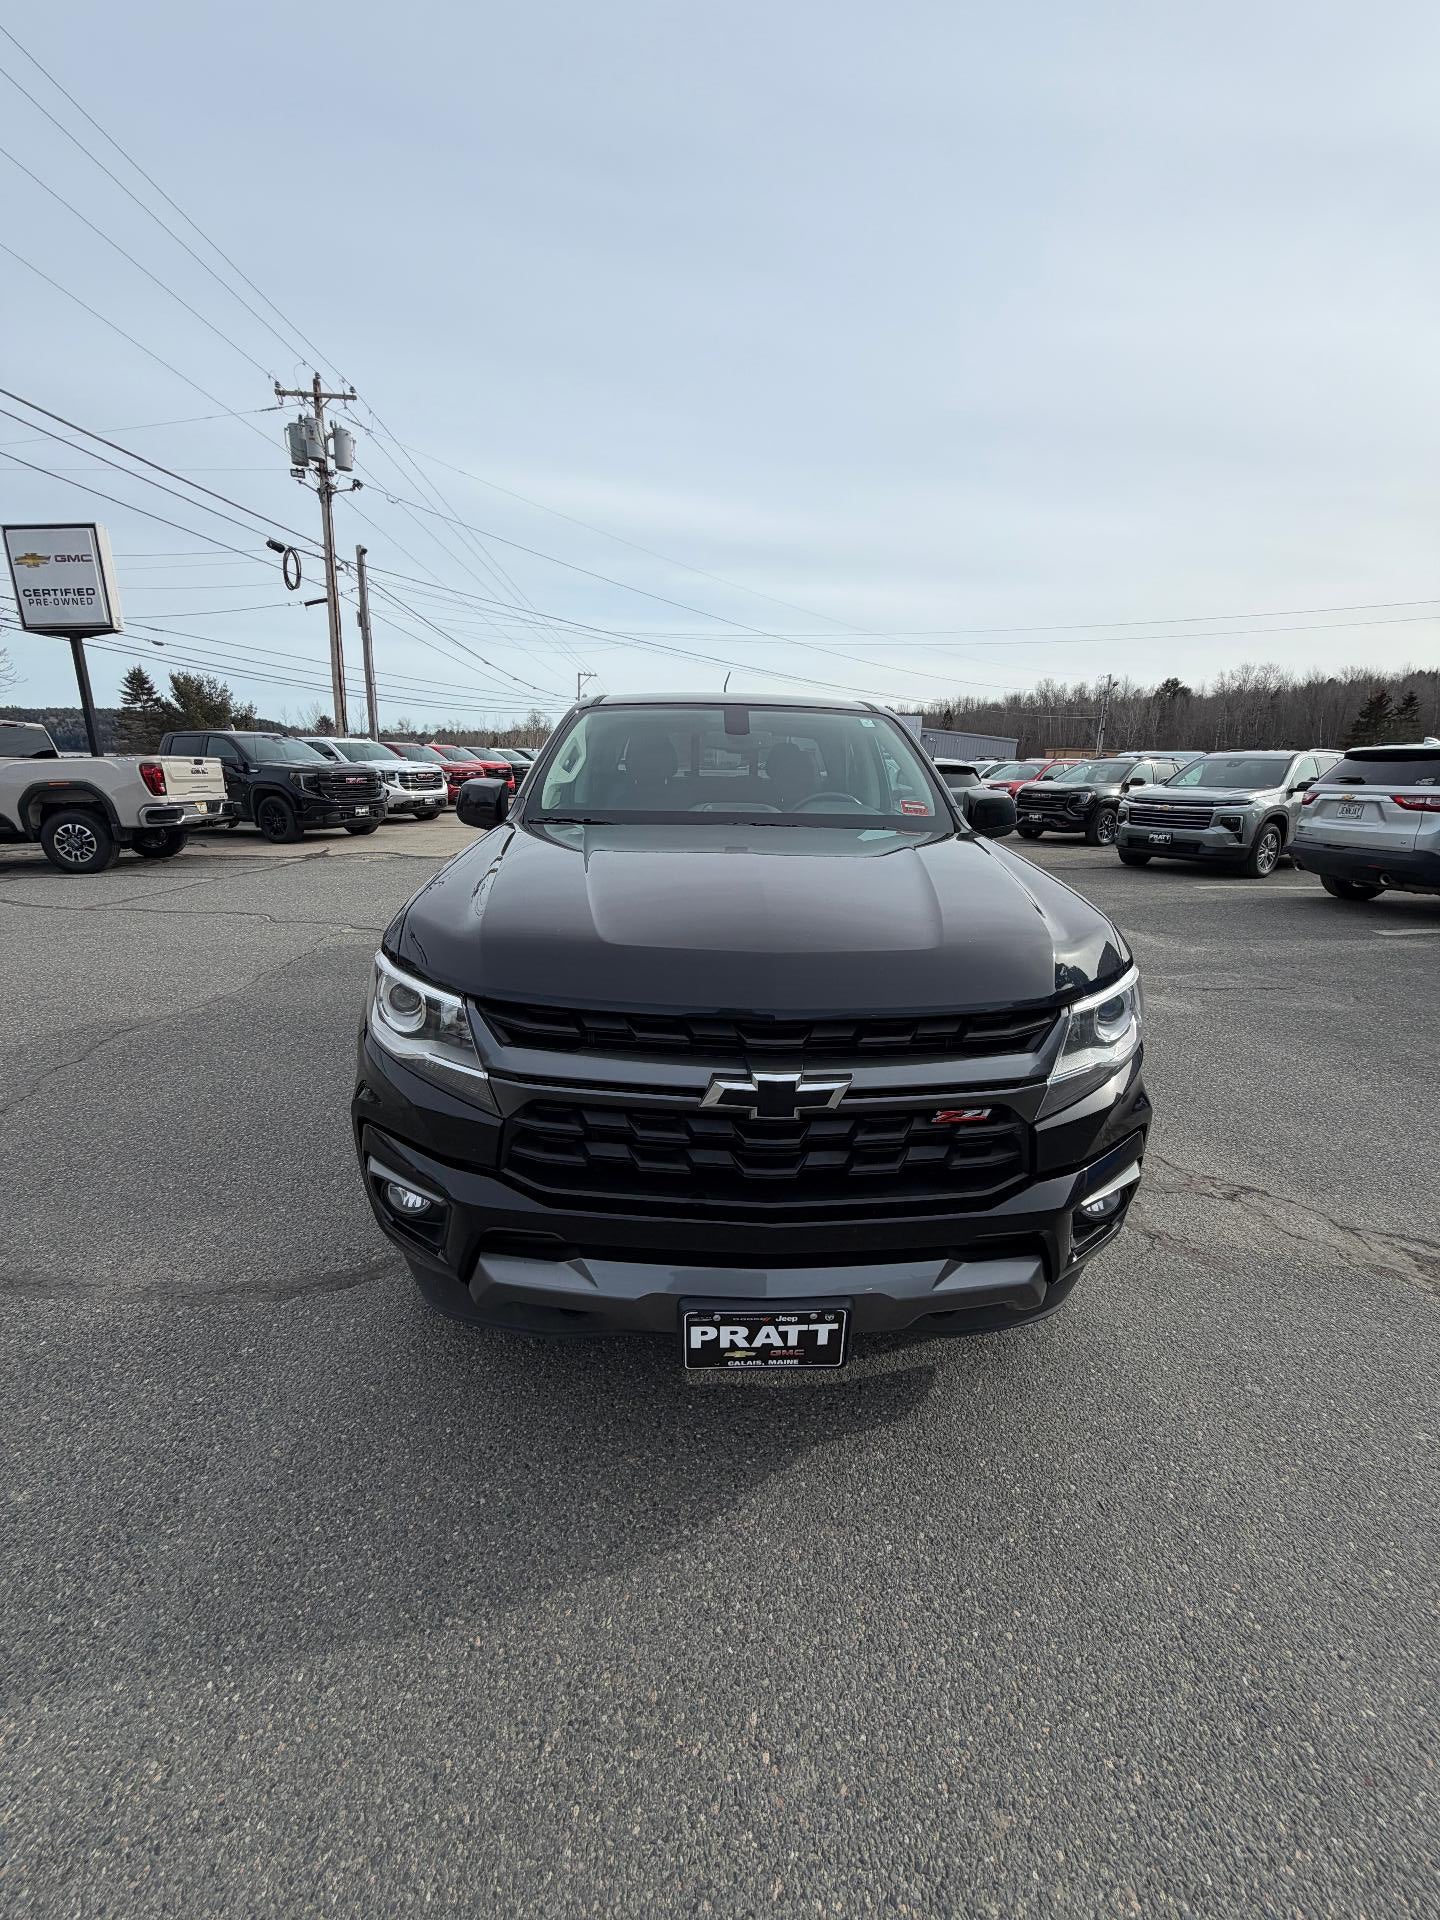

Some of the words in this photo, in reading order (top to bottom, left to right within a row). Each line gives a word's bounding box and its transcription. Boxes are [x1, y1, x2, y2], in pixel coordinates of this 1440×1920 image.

[54, 554, 93, 562] GMC
[22, 588, 96, 597] CERTIFIED
[28, 598, 93, 606] PRE-OWNED
[1150, 833, 1171, 841] PRATT
[931, 1108, 993, 1123] Z71
[775, 1315, 798, 1323] Jeep
[689, 1323, 839, 1349] PRATT
[769, 1349, 805, 1357] GMC
[727, 1359, 765, 1367] CALAIS,
